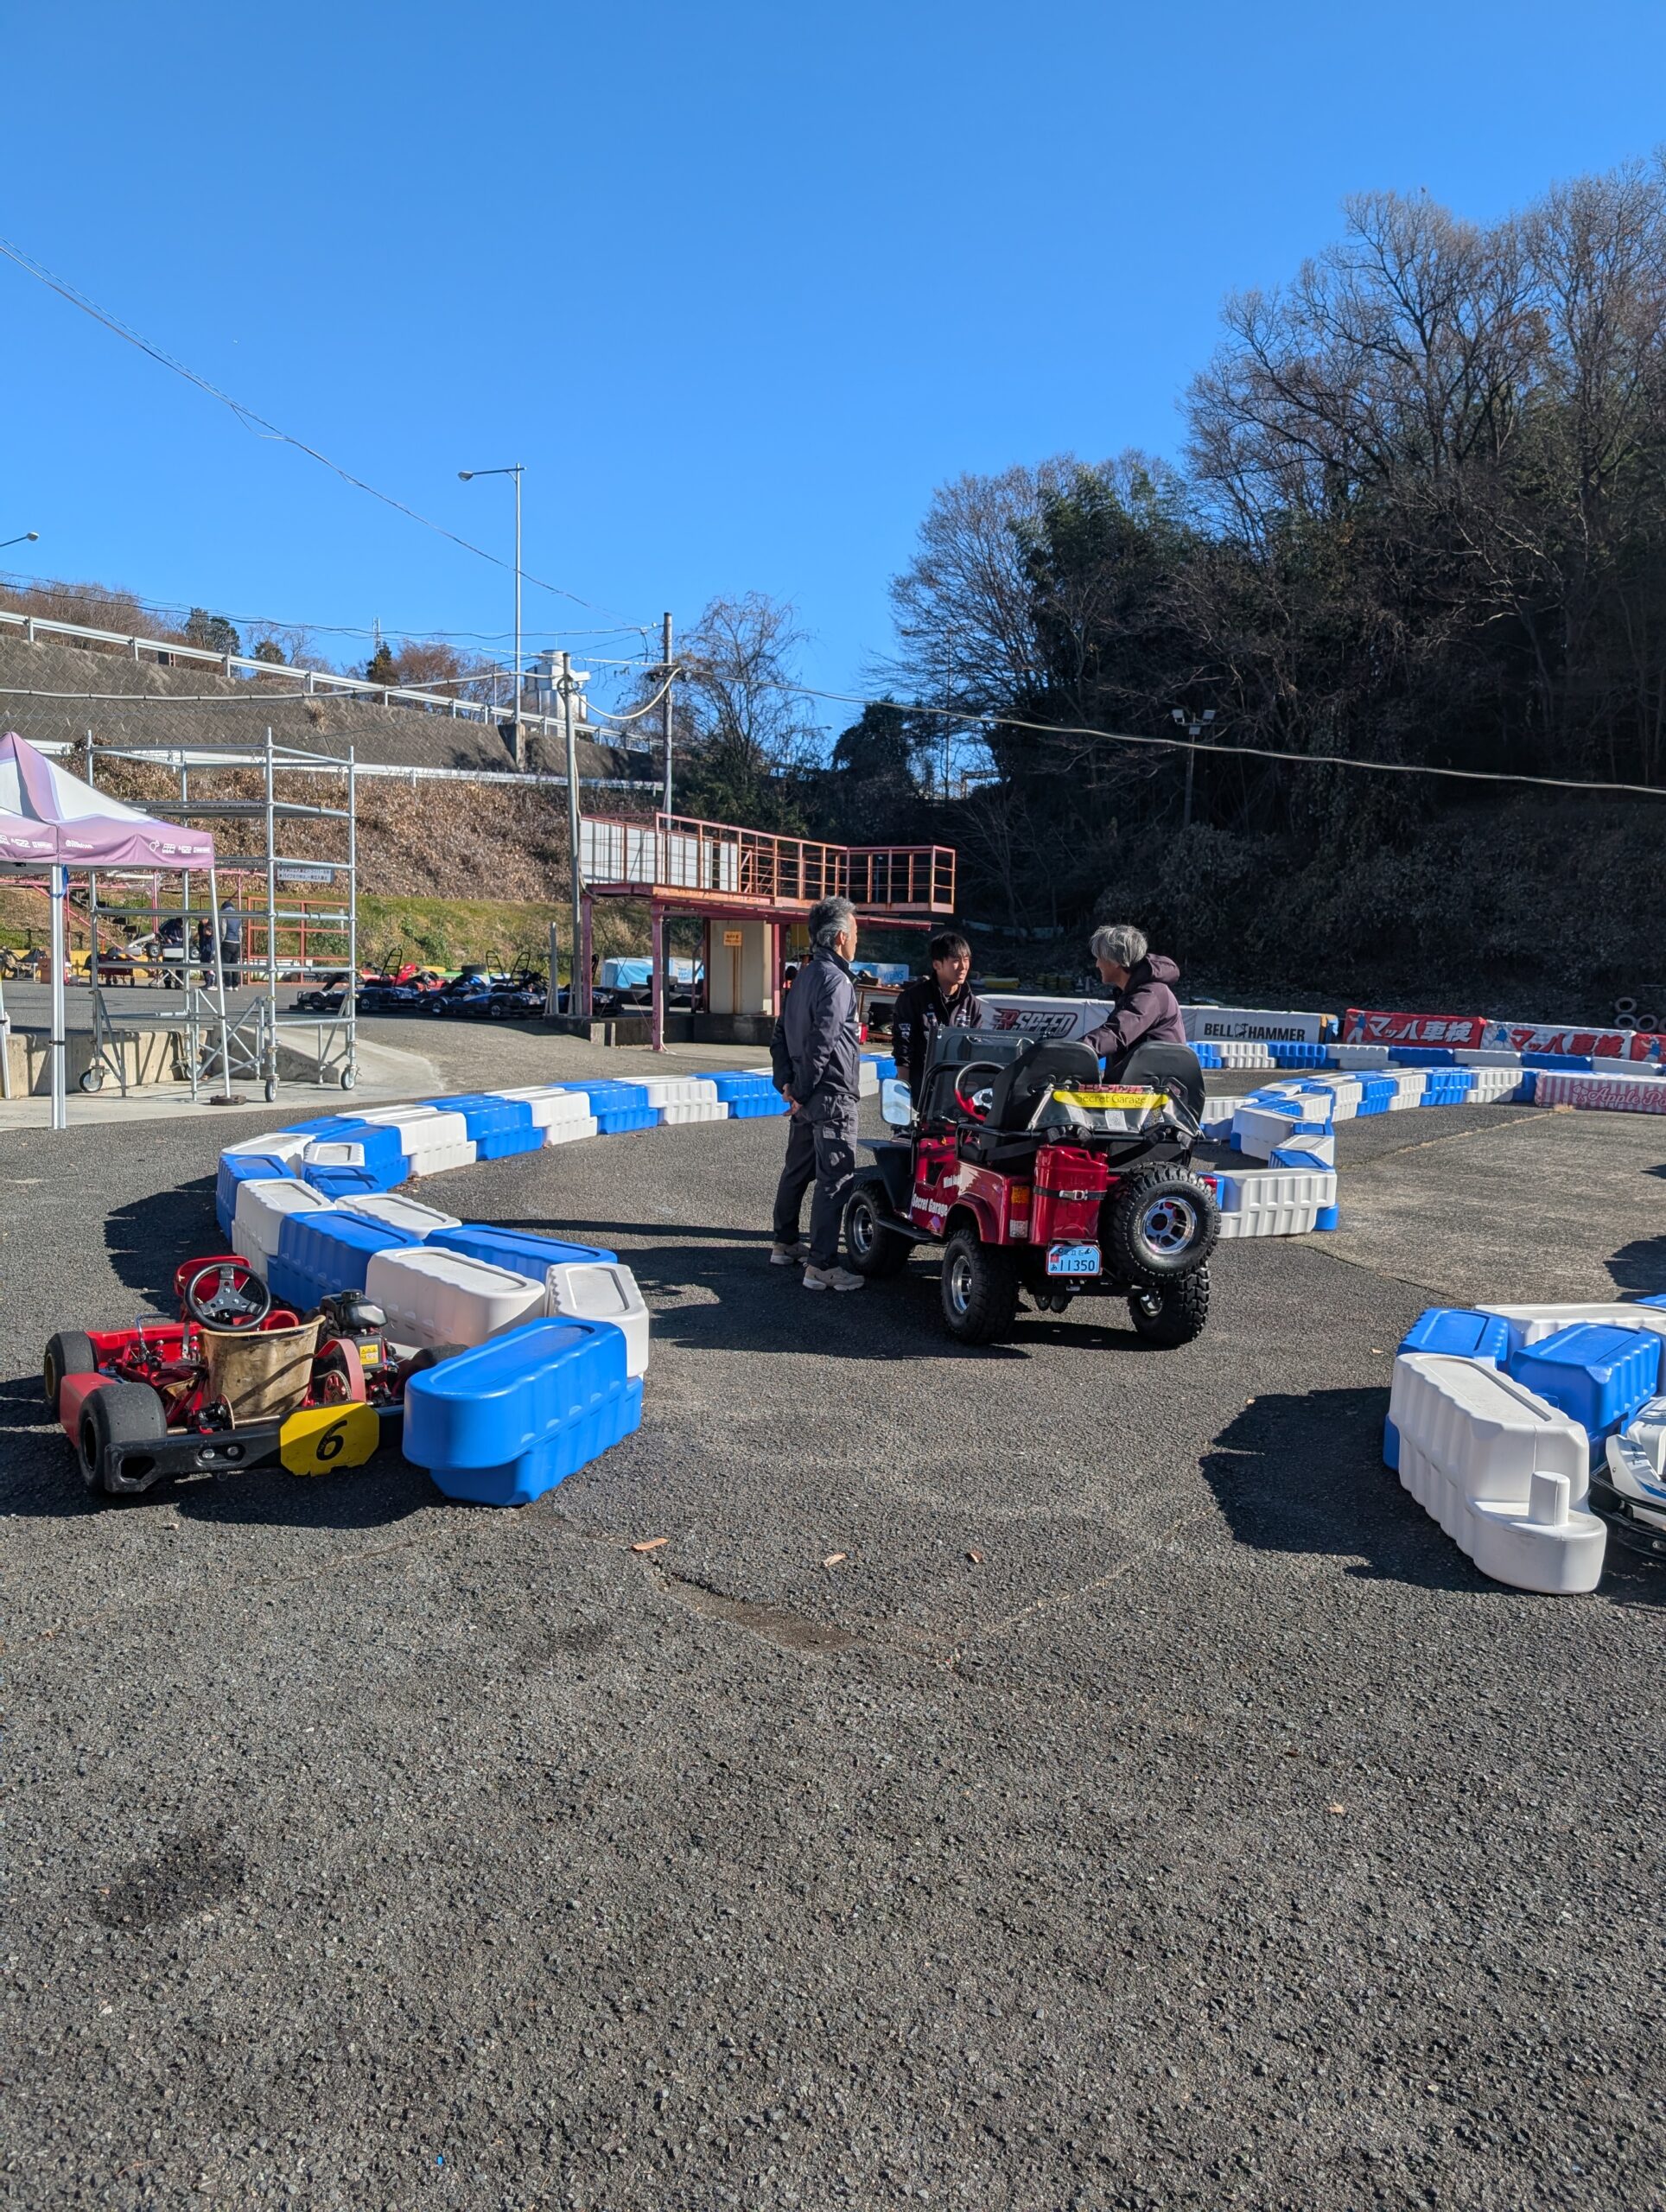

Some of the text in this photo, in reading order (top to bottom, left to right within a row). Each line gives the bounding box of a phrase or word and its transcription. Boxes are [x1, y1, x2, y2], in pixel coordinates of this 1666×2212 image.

[1204, 1022, 1306, 1042] BELL HAMMER
[1369, 1016, 1472, 1043] マッハ車検
[1510, 1028, 1625, 1058] マッハ車検
[1076, 1094, 1147, 1107] Secret Garage
[1587, 1086, 1640, 1108] Apple
[912, 1193, 948, 1217] Secret Garage
[1060, 1259, 1096, 1272] 11350
[315, 1419, 348, 1461] 6
